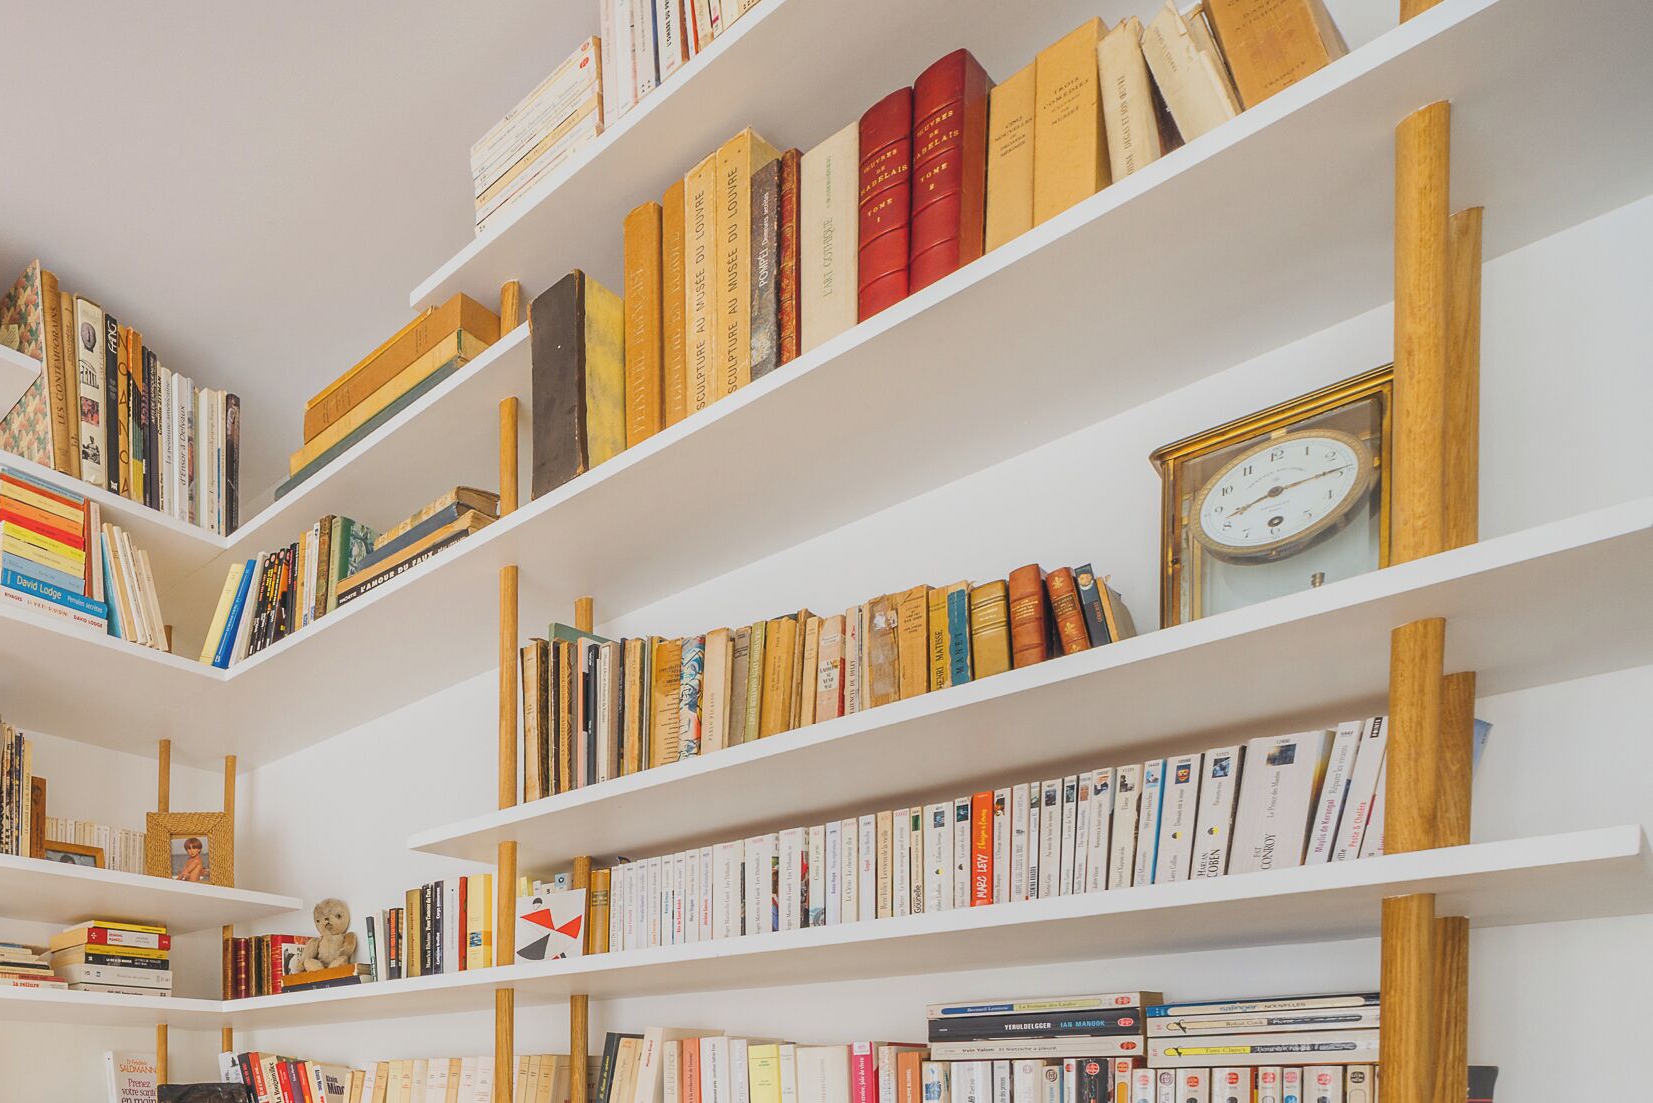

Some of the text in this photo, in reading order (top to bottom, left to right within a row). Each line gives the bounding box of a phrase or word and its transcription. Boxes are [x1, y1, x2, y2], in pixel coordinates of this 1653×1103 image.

[1041, 78, 1090, 112] COMÉDIES
[1053, 76, 1081, 97] TROIS
[929, 129, 940, 139] DE
[995, 117, 1033, 142] NOUVELLES
[876, 165, 886, 175] DE
[919, 162, 948, 183] TOME
[861, 164, 908, 198] RABELAIS
[929, 182, 936, 191] 2
[867, 198, 893, 217] TOME
[761, 213, 770, 247] Demeures
[822, 217, 834, 268] GOTHIQUE
[727, 166, 739, 394] SCULPTURE AU MUSÉE DU LOUVRE
[822, 269, 834, 298] L'ART
[695, 190, 707, 411] SCULPTURE AU MUSÉE DU LOUVRE
[51, 307, 67, 427] LES CONTEMPORAINS
[1270, 449, 1284, 462] 12
[1305, 446, 1309, 456] 1
[1325, 450, 1337, 461] 2
[179, 452, 187, 486] d'Ensor
[1243, 465, 1253, 477] 11
[1222, 485, 1233, 497] 10
[1327, 489, 1333, 500] 4
[1214, 505, 1224, 514] 9
[1222, 521, 1232, 532] 8
[360, 551, 434, 593] L'AMOUR DU FAUX
[4, 592, 23, 602] RIVAGES
[16, 576, 62, 600] David Lodge
[67, 595, 85, 608] Pensées
[85, 600, 103, 614] secrètes
[74, 614, 88, 624] DAVID
[935, 629, 943, 661] MATISSE
[955, 631, 965, 675] MANET
[1329, 776, 1340, 795] Réparer
[1338, 744, 1348, 765] vivants
[1315, 833, 1327, 854] Maylis
[1324, 799, 1336, 823] Kerangal
[1348, 830, 1357, 848] Peste
[1354, 801, 1367, 822] Choléra
[1253, 847, 1261, 858] PAT
[1262, 833, 1276, 870] CONROY
[1197, 853, 1207, 877] HARLAN
[1207, 849, 1220, 878] COBEN
[976, 853, 988, 898] MARC LEVY
[913, 884, 922, 914] Gounelle
[1220, 1001, 1306, 1012] salinger NOUVELLES
[119, 1064, 157, 1074] SALDMANN
[122, 1088, 138, 1096] votre
[128, 1079, 151, 1088] Prenez
[327, 1082, 345, 1096] Minc
